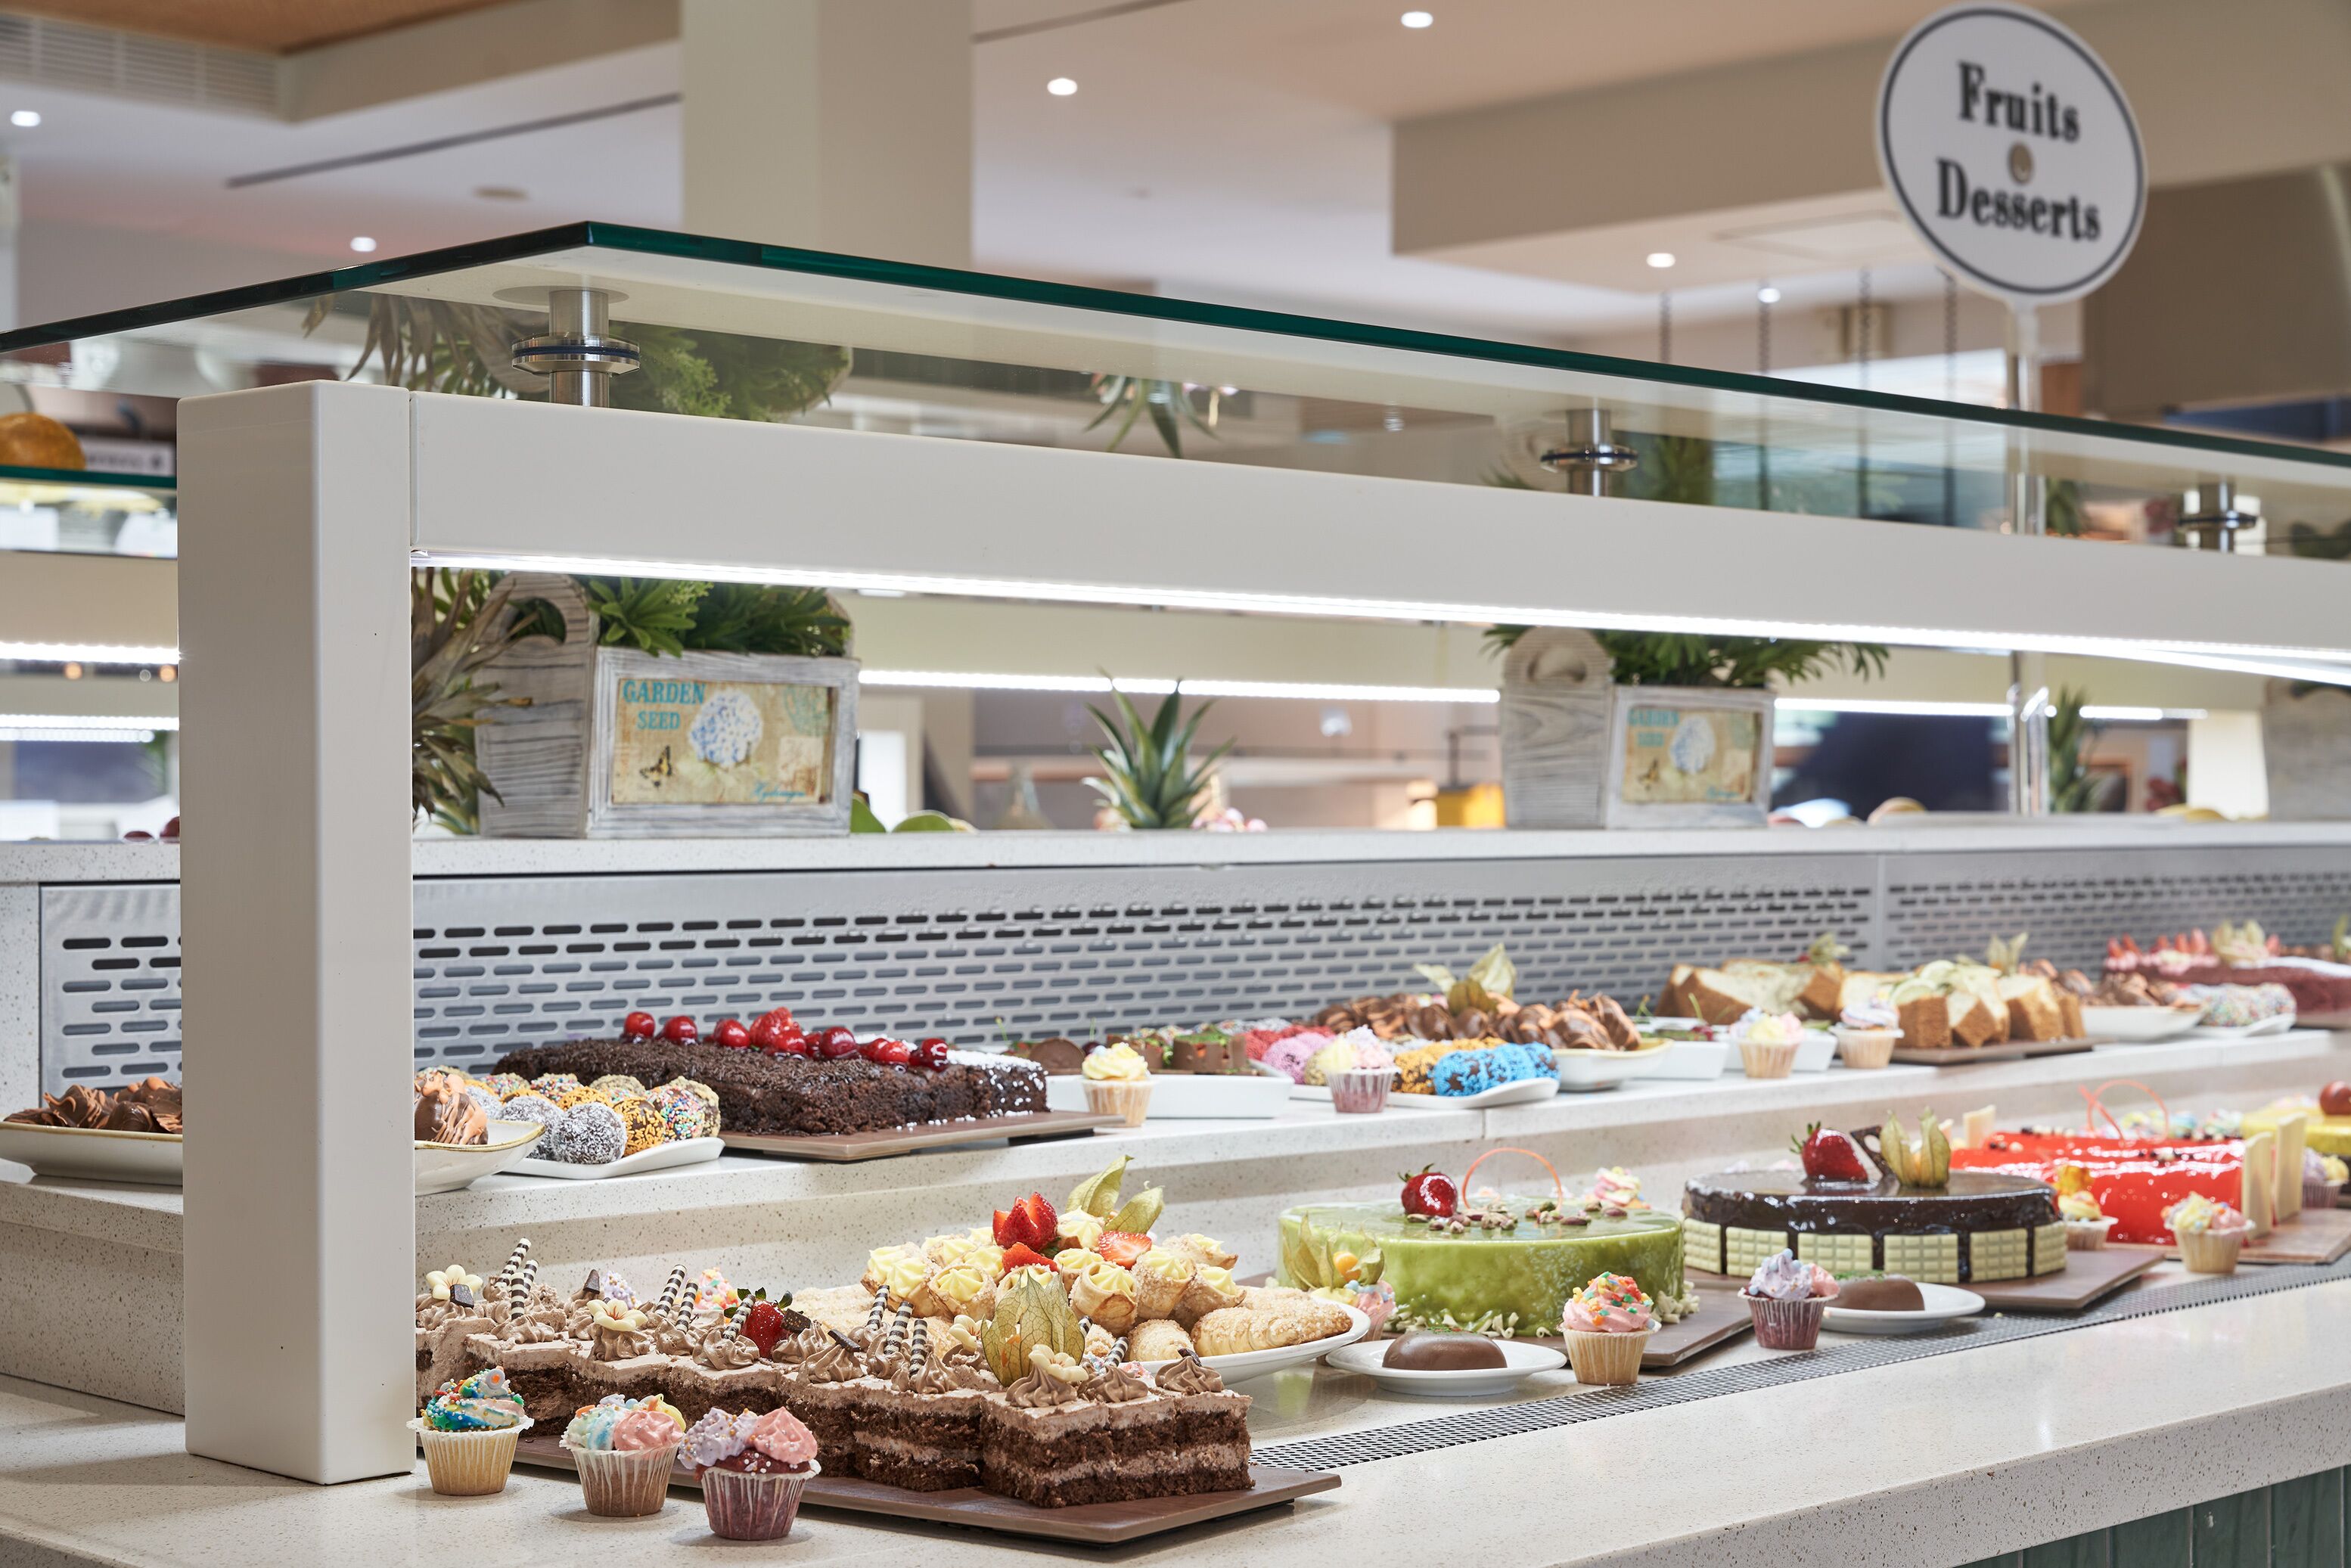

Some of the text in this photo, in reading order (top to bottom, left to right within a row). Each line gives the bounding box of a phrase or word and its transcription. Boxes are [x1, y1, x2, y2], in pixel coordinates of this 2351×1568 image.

[1958, 61, 2079, 142] Fruits
[1936, 157, 2101, 241] Desserts
[623, 679, 706, 704] GARDEN
[637, 711, 680, 729] SEED
